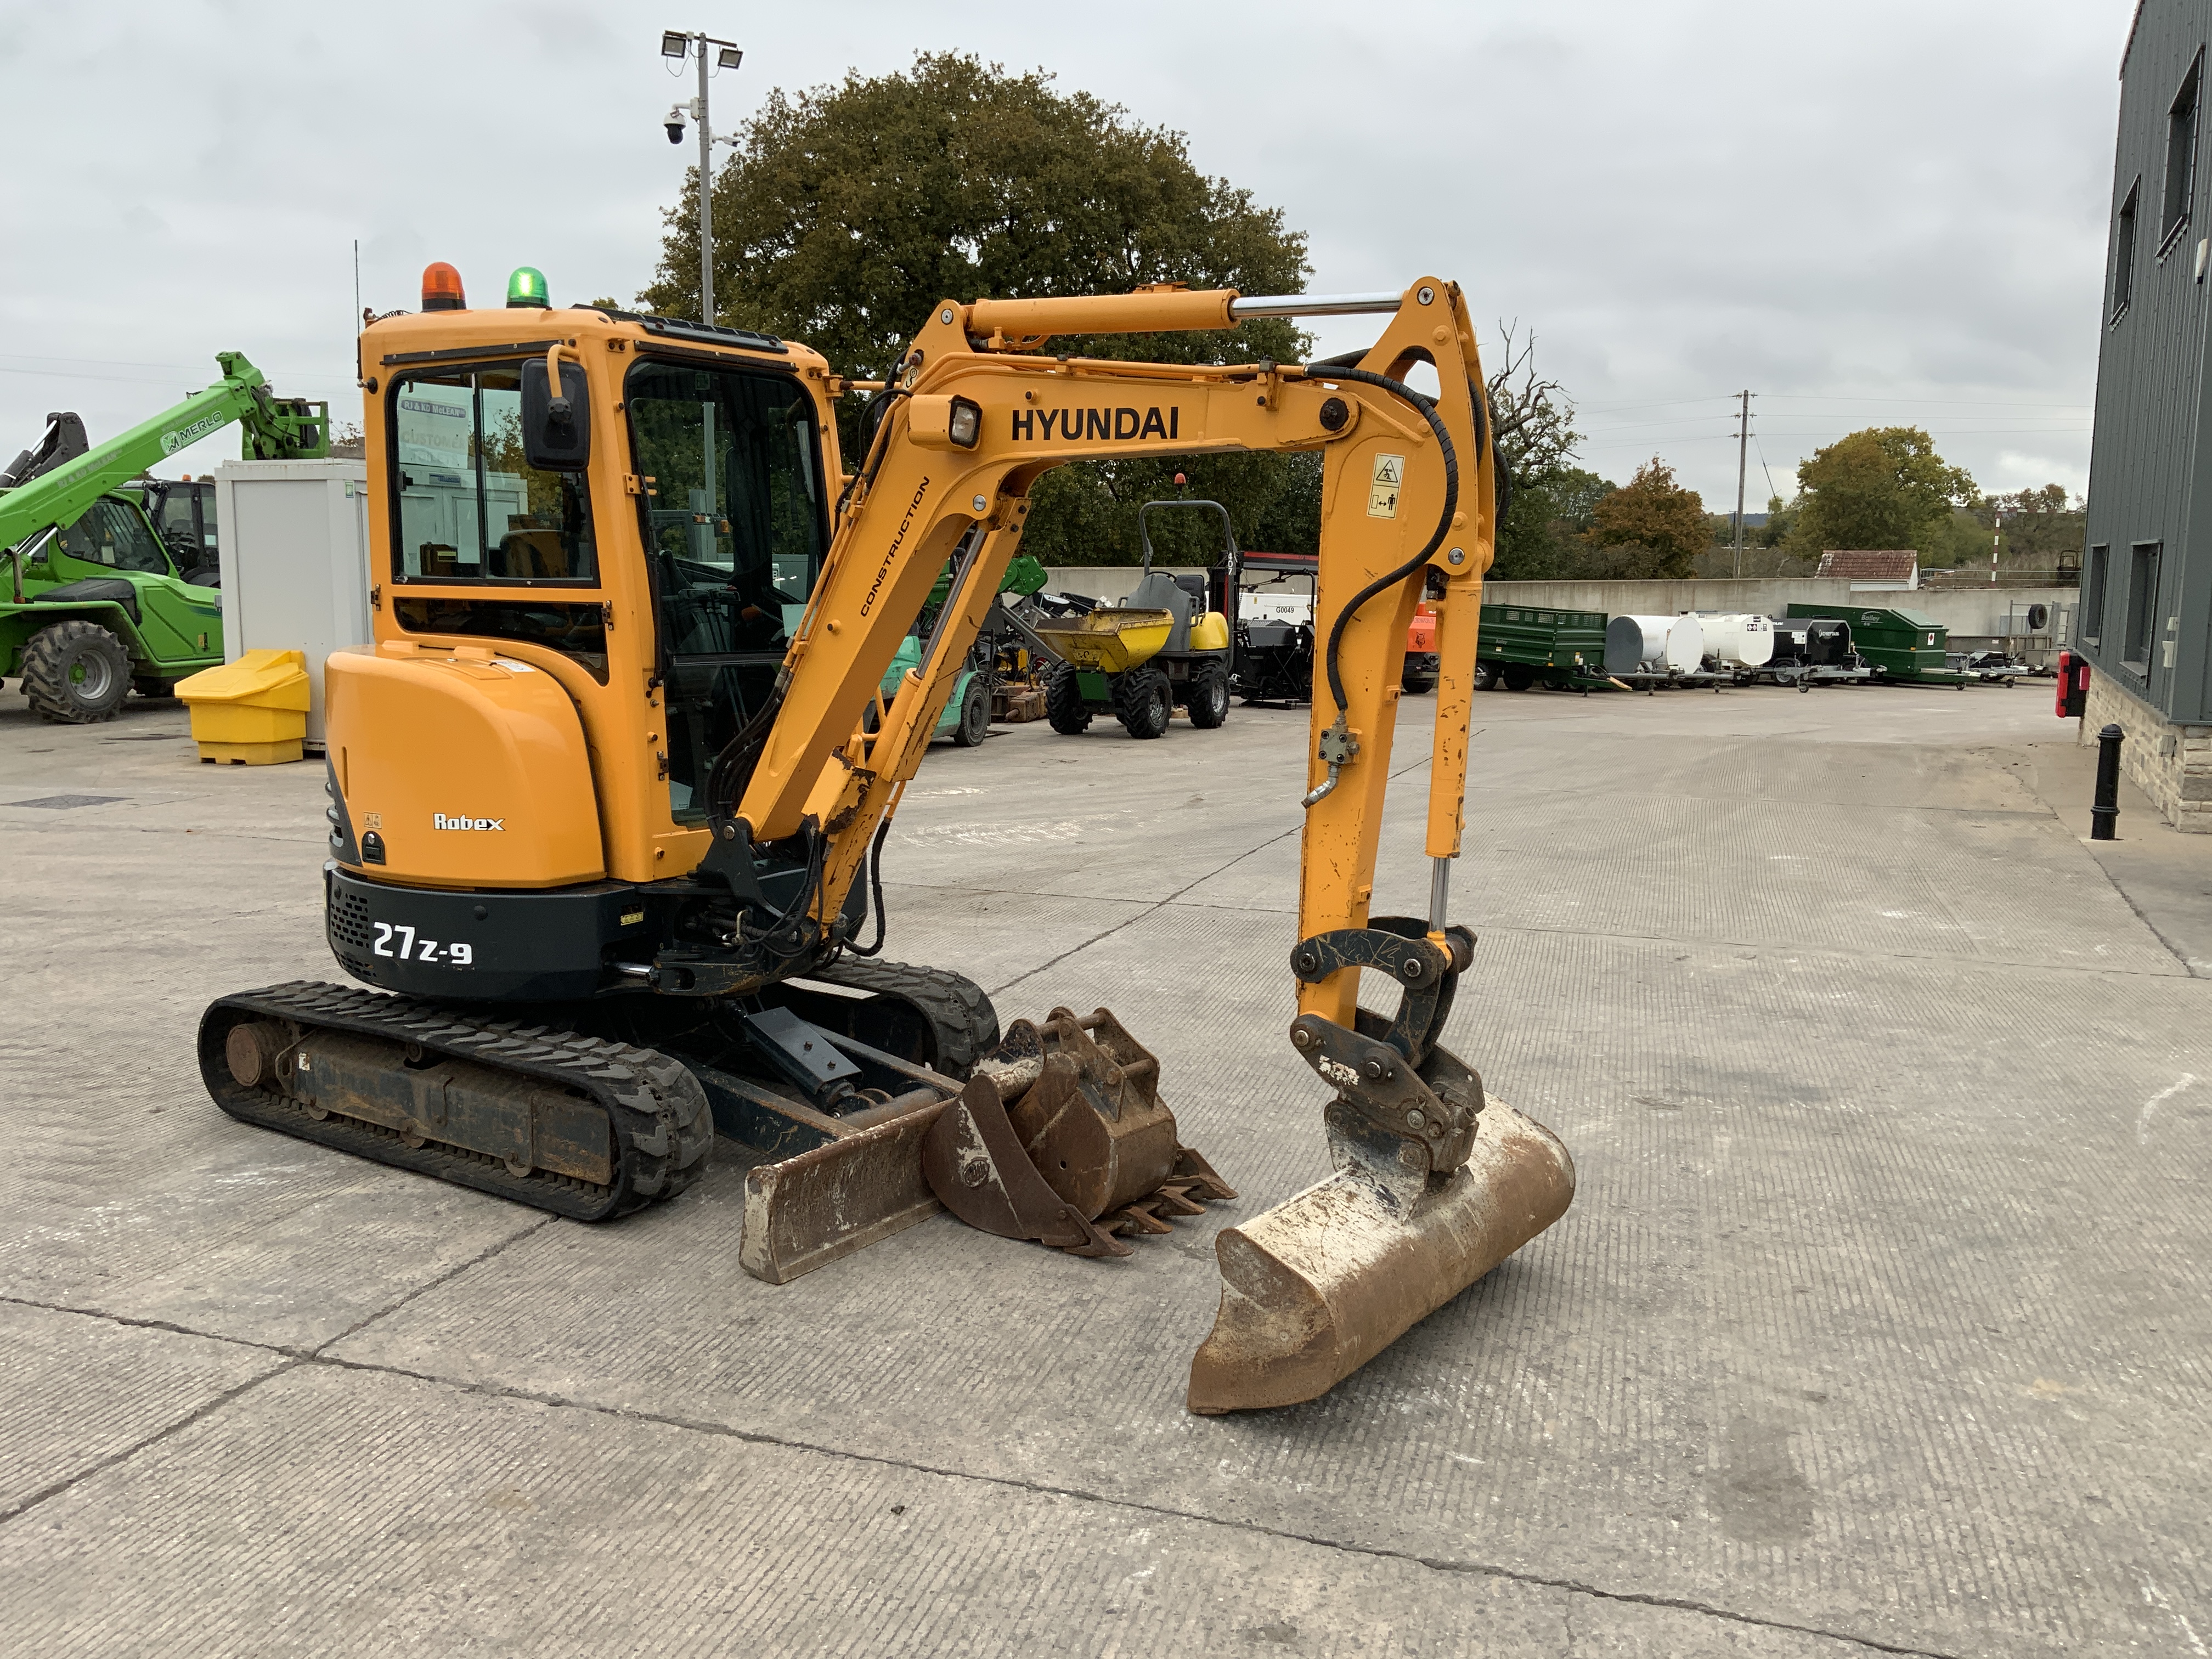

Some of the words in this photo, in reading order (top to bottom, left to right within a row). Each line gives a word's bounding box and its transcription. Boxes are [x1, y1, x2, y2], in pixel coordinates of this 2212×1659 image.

[421, 403, 431, 412] KD
[179, 411, 222, 442] MERLO
[1012, 407, 1178, 441] HYUNDAI
[860, 476, 930, 617] CONSTRUCTION
[1861, 614, 1880, 623] Bailey
[433, 812, 506, 831] Robex
